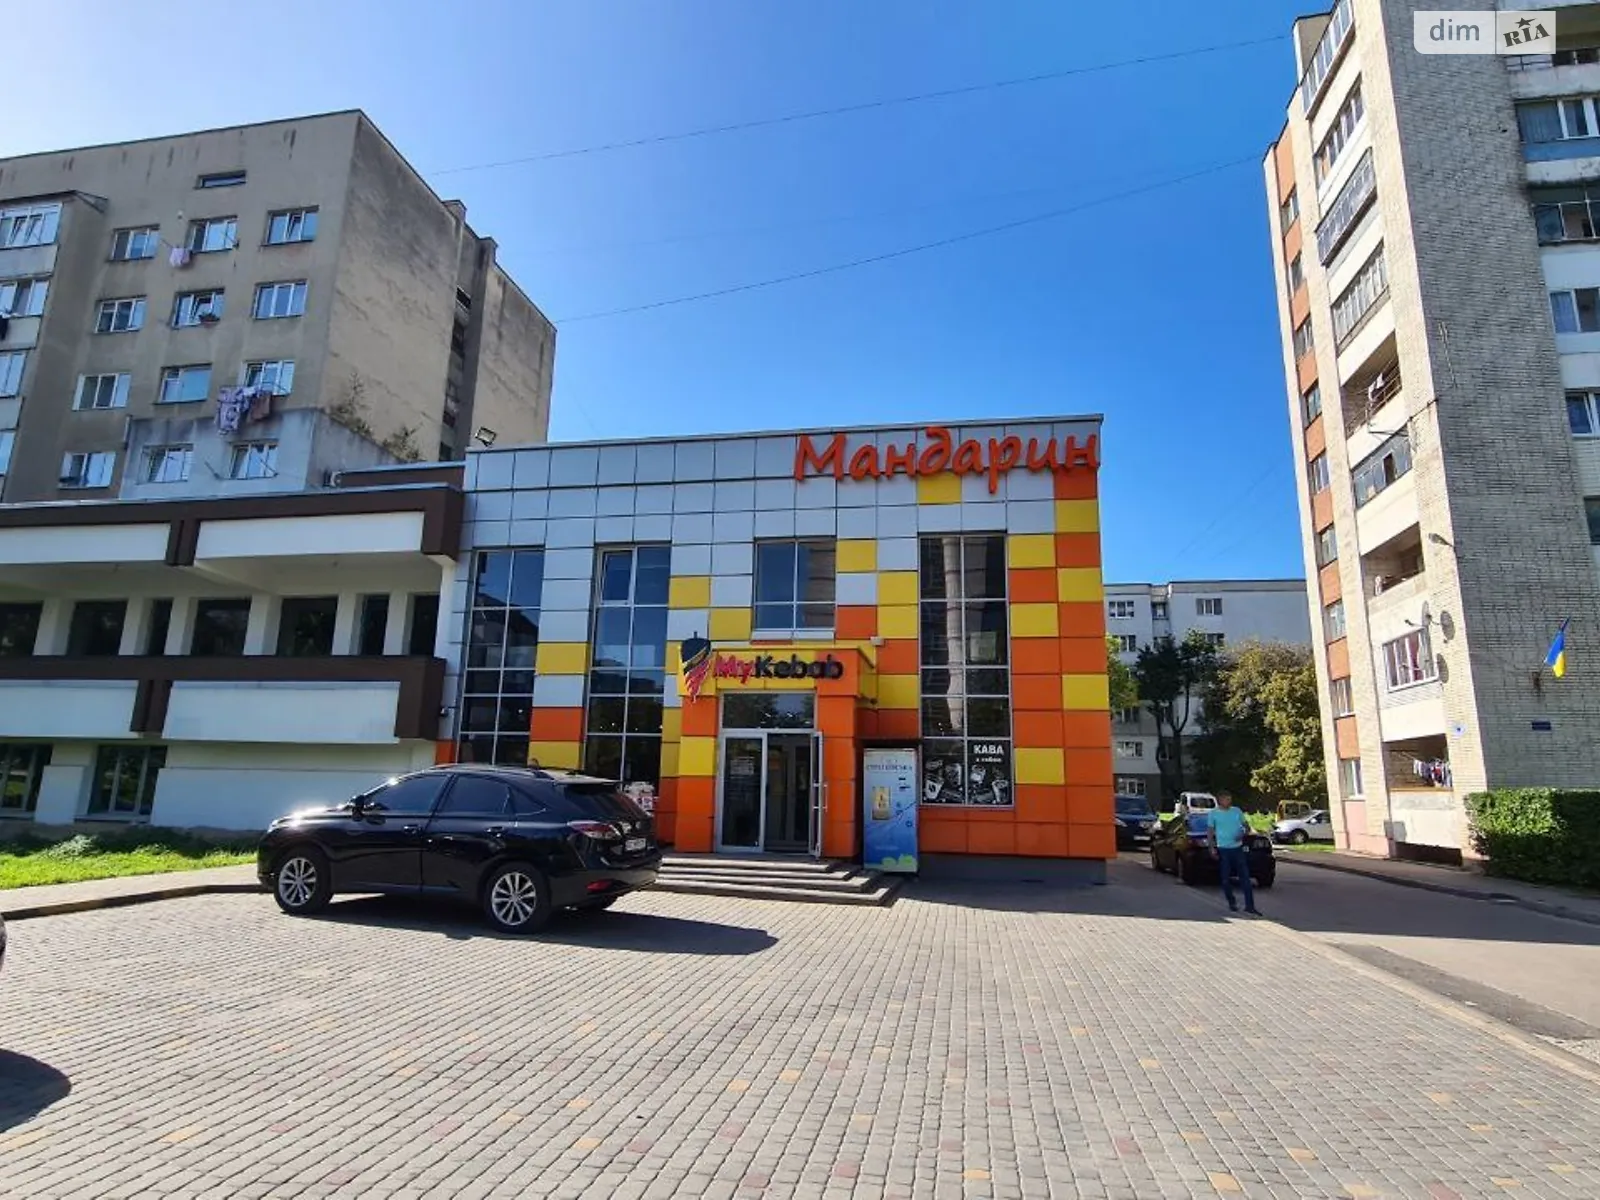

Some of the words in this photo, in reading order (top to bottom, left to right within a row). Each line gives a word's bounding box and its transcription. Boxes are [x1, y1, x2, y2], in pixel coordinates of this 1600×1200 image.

[794, 426, 1098, 495] Мандарин
[713, 653, 844, 685] MyKebab
[973, 744, 1005, 755] КАВА
